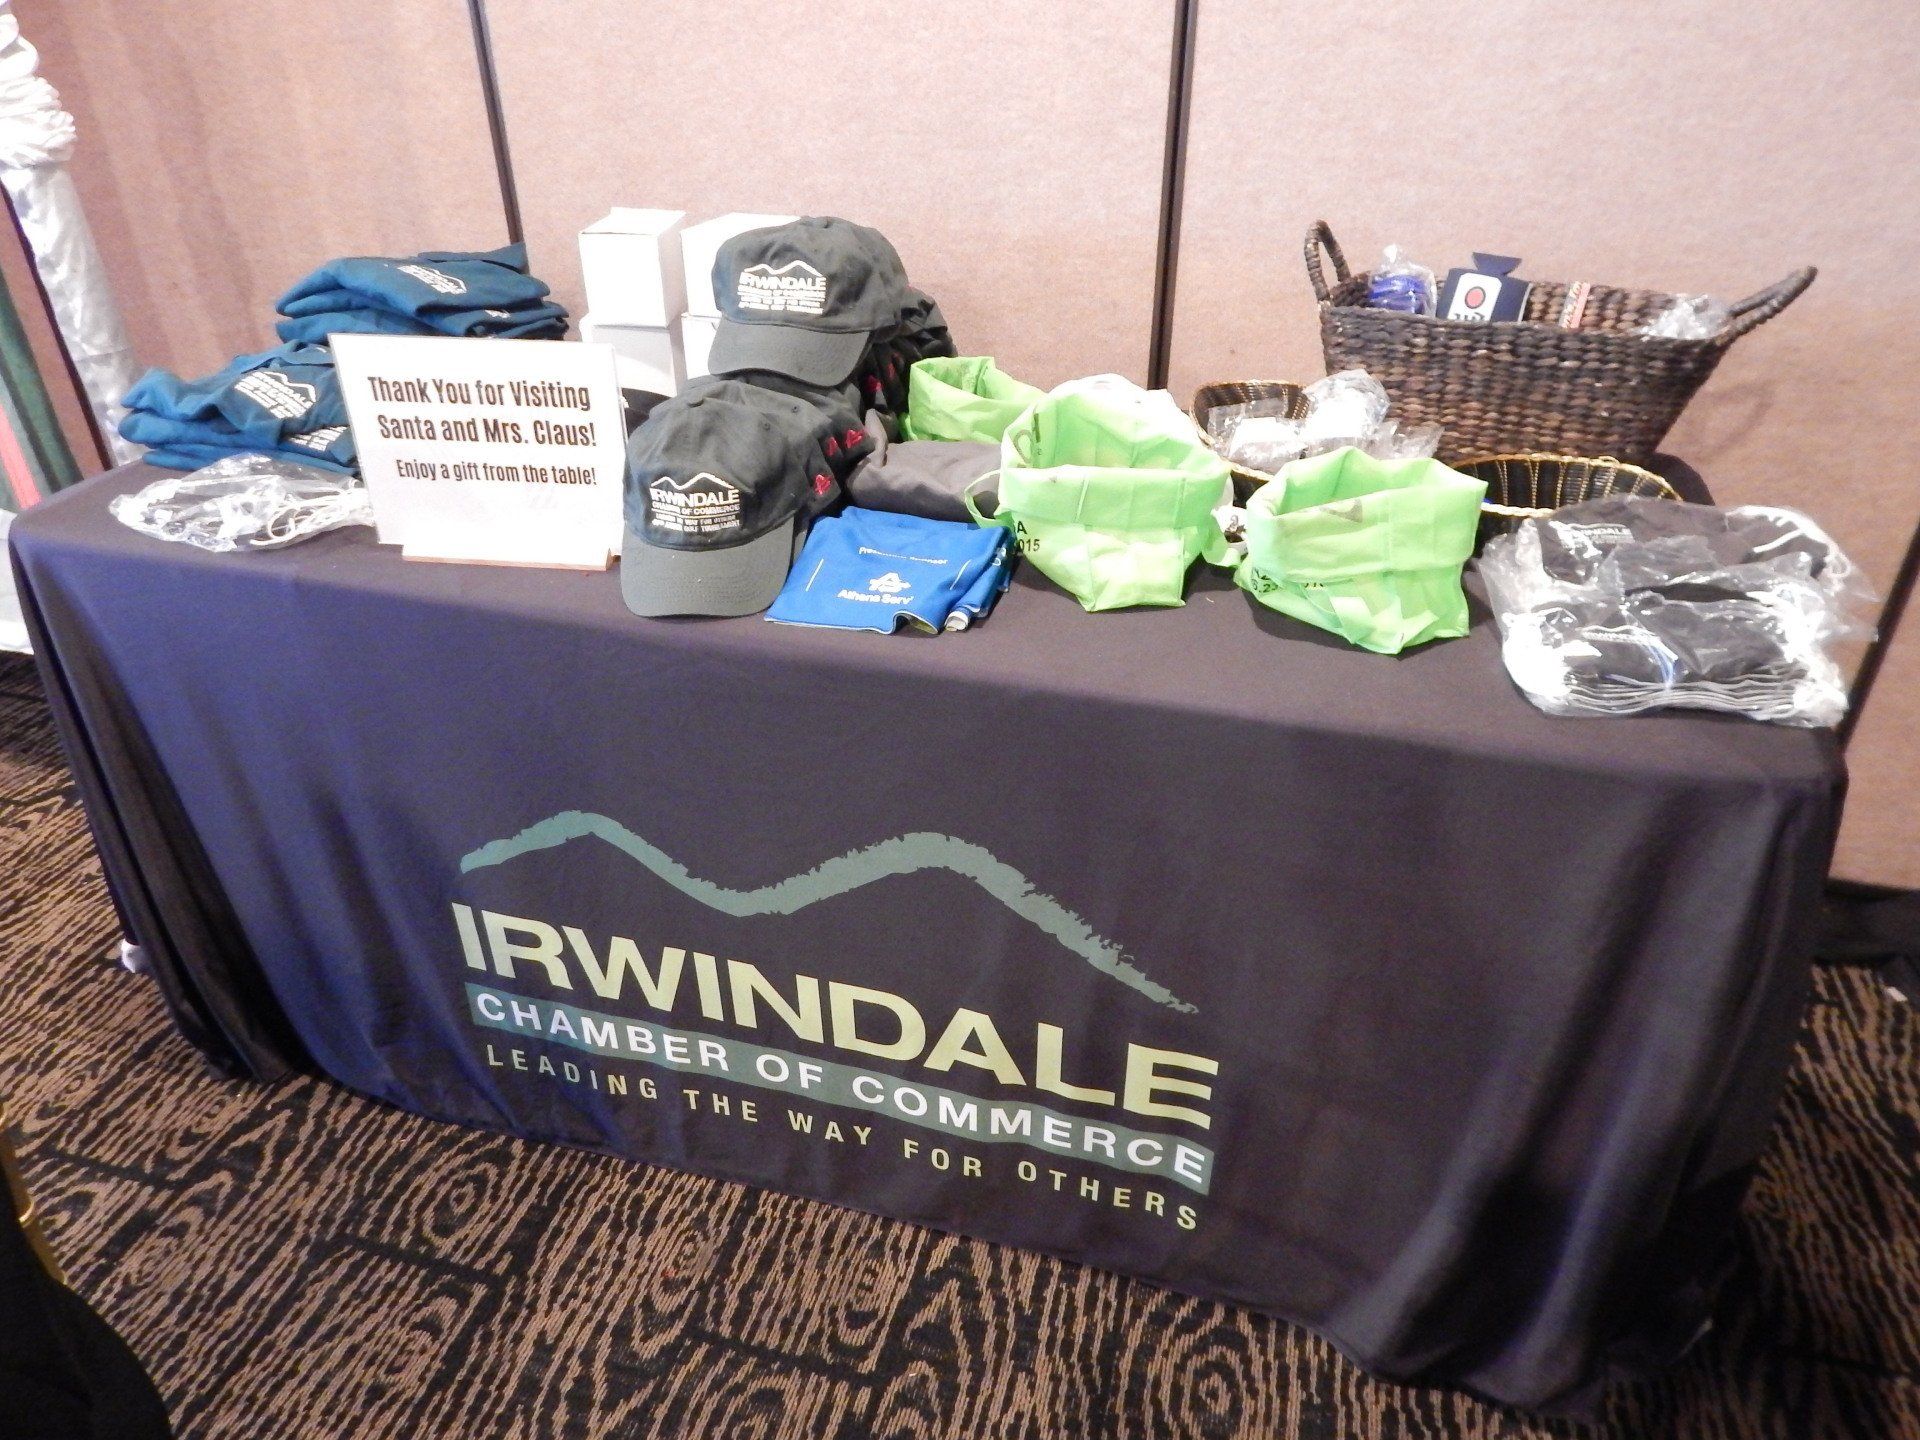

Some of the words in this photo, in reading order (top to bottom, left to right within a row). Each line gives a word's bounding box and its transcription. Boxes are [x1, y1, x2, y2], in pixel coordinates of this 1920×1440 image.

[367, 376, 431, 403] Thank
[432, 378, 472, 404] You
[475, 380, 505, 406] for
[509, 380, 591, 411] Visiting
[377, 415, 437, 441] Santa
[441, 418, 479, 442] and
[482, 418, 529, 444] Mrs.
[533, 420, 597, 447] Claus!
[396, 459, 436, 480] Enjoy
[440, 464, 450, 479] a
[453, 461, 481, 481] gift
[483, 462, 520, 482] from
[522, 464, 549, 483] the
[551, 465, 597, 485] table!
[452, 902, 1219, 1130] IRWINDALE
[476, 993, 729, 1071] CHAMBER
[755, 1054, 824, 1089] OF
[852, 1075, 1205, 1183] COMMERCE
[487, 1044, 658, 1100] LEADING
[683, 1088, 758, 1122] THE
[788, 1109, 872, 1145] WAY
[903, 1138, 983, 1178] FOR
[1018, 1160, 1197, 1231] OTHERS
